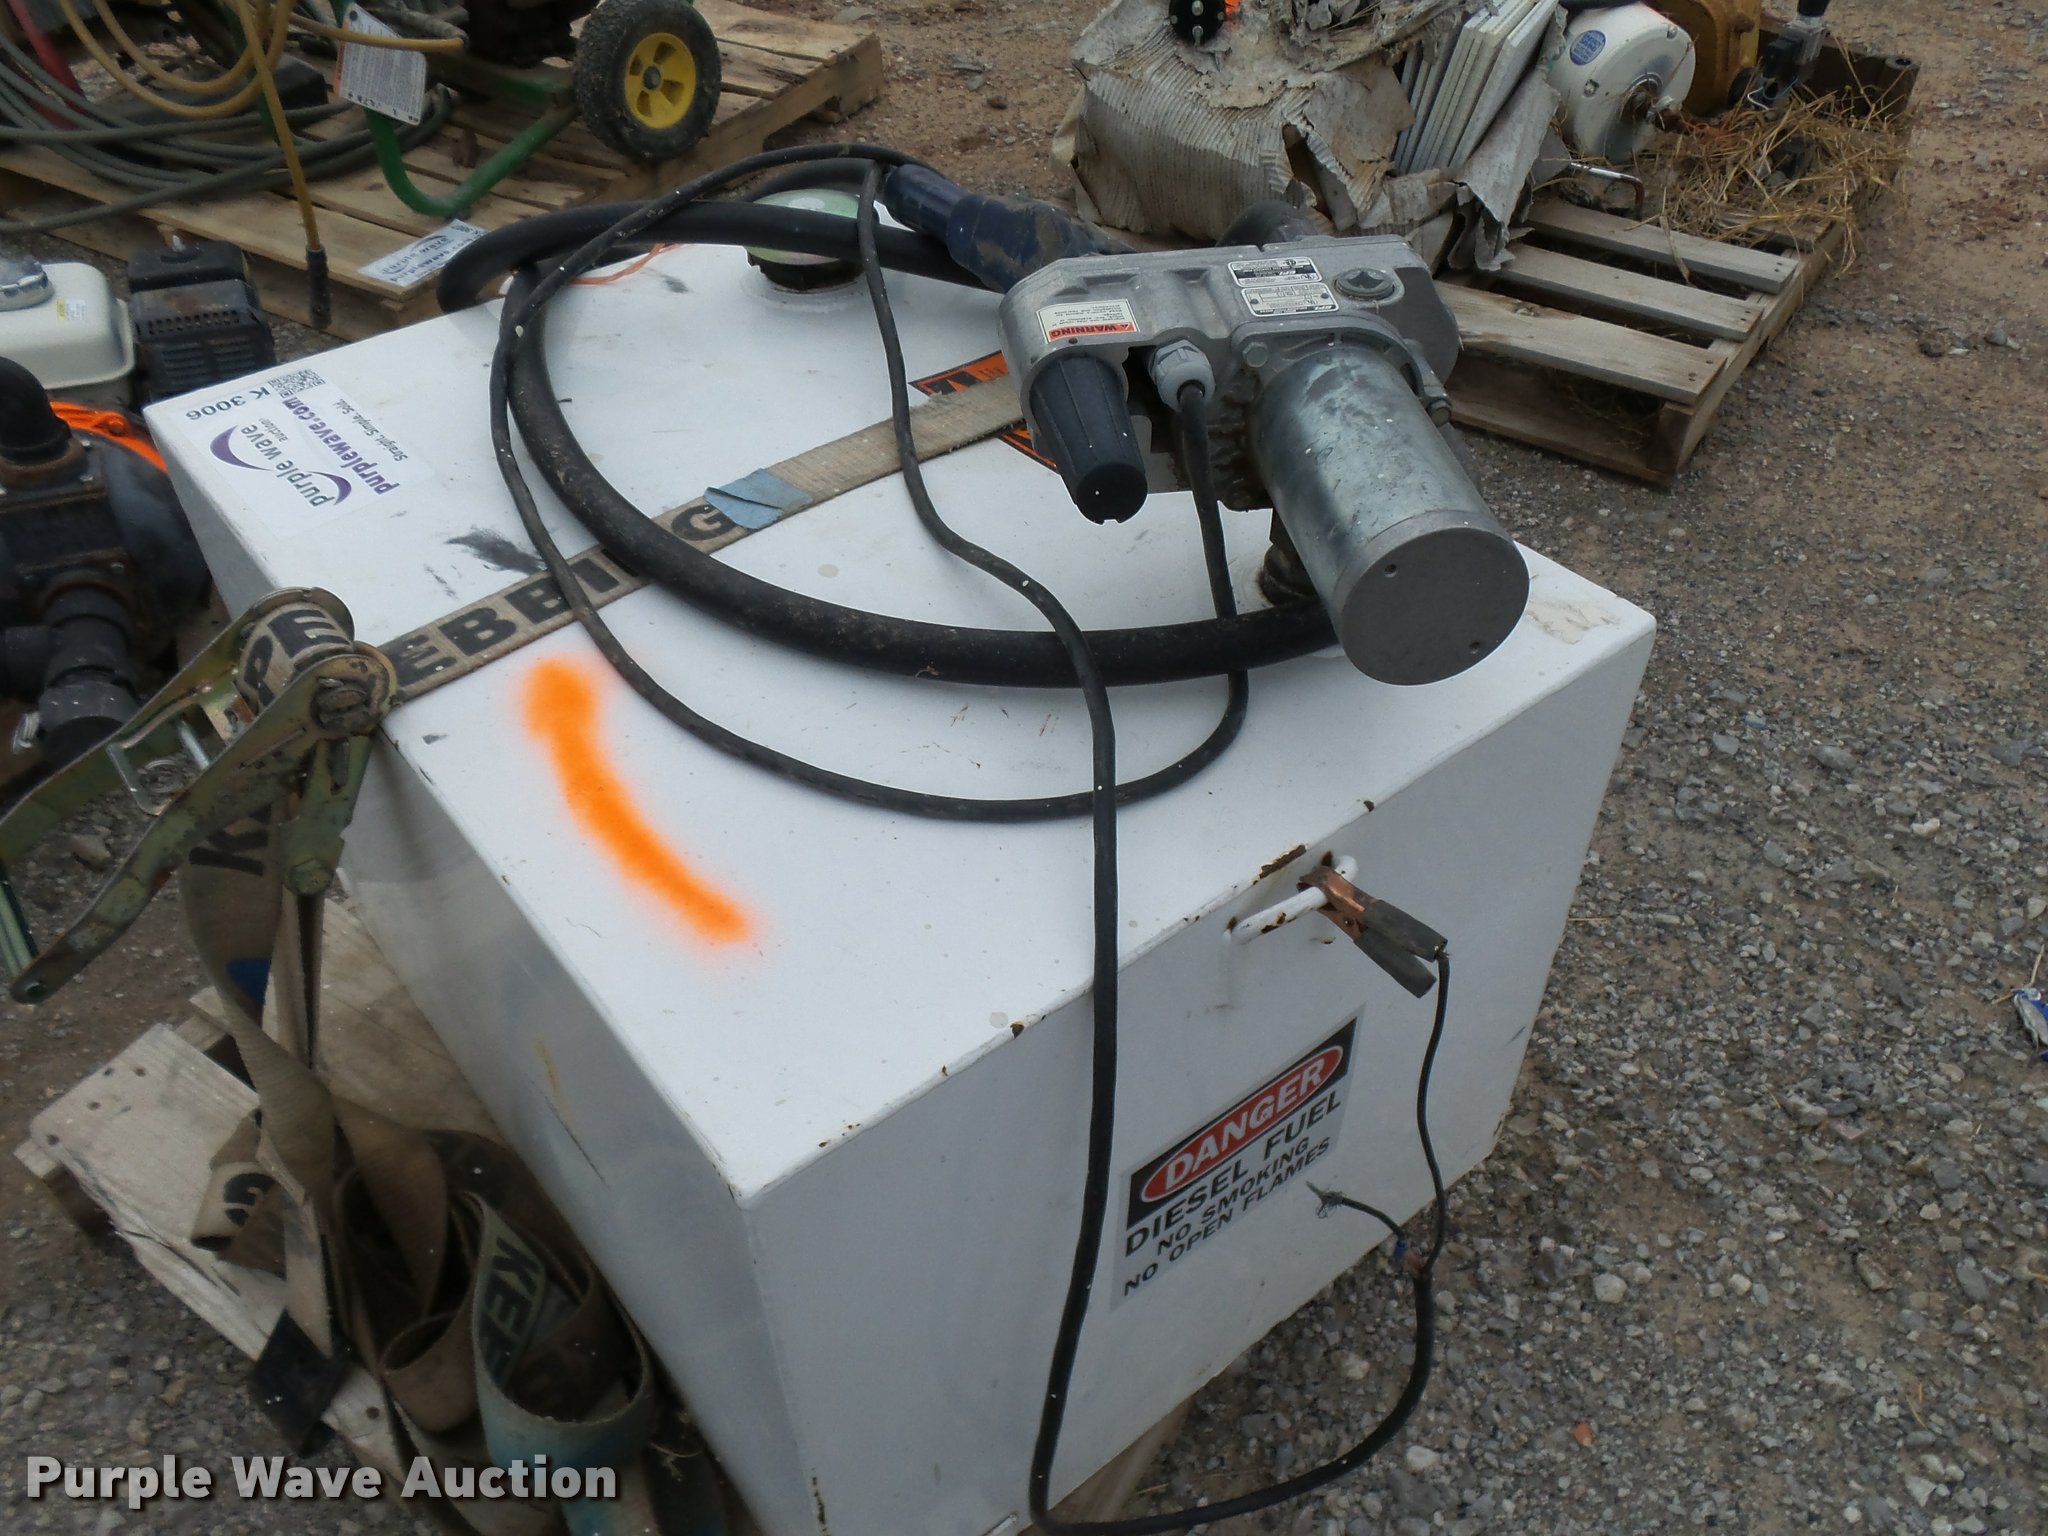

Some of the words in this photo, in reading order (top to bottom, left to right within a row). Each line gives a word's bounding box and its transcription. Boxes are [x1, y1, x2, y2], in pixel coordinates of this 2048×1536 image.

[1050, 323, 1114, 340] WARNING
[185, 394, 247, 421] 3006
[249, 386, 271, 400] K
[241, 424, 283, 460] wave
[282, 396, 400, 496] purplewave.com
[275, 460, 336, 507] purple
[1164, 1057, 1326, 1191] DANGER
[1125, 1160, 1249, 1258] DIESEL
[1263, 1090, 1341, 1160] FUEL
[1157, 1222, 1192, 1256] NO
[1201, 1136, 1310, 1225] SMOKING
[1123, 1262, 1158, 1296] NO
[1169, 1209, 1233, 1261] OPEN
[1242, 1136, 1331, 1212] FLAMES
